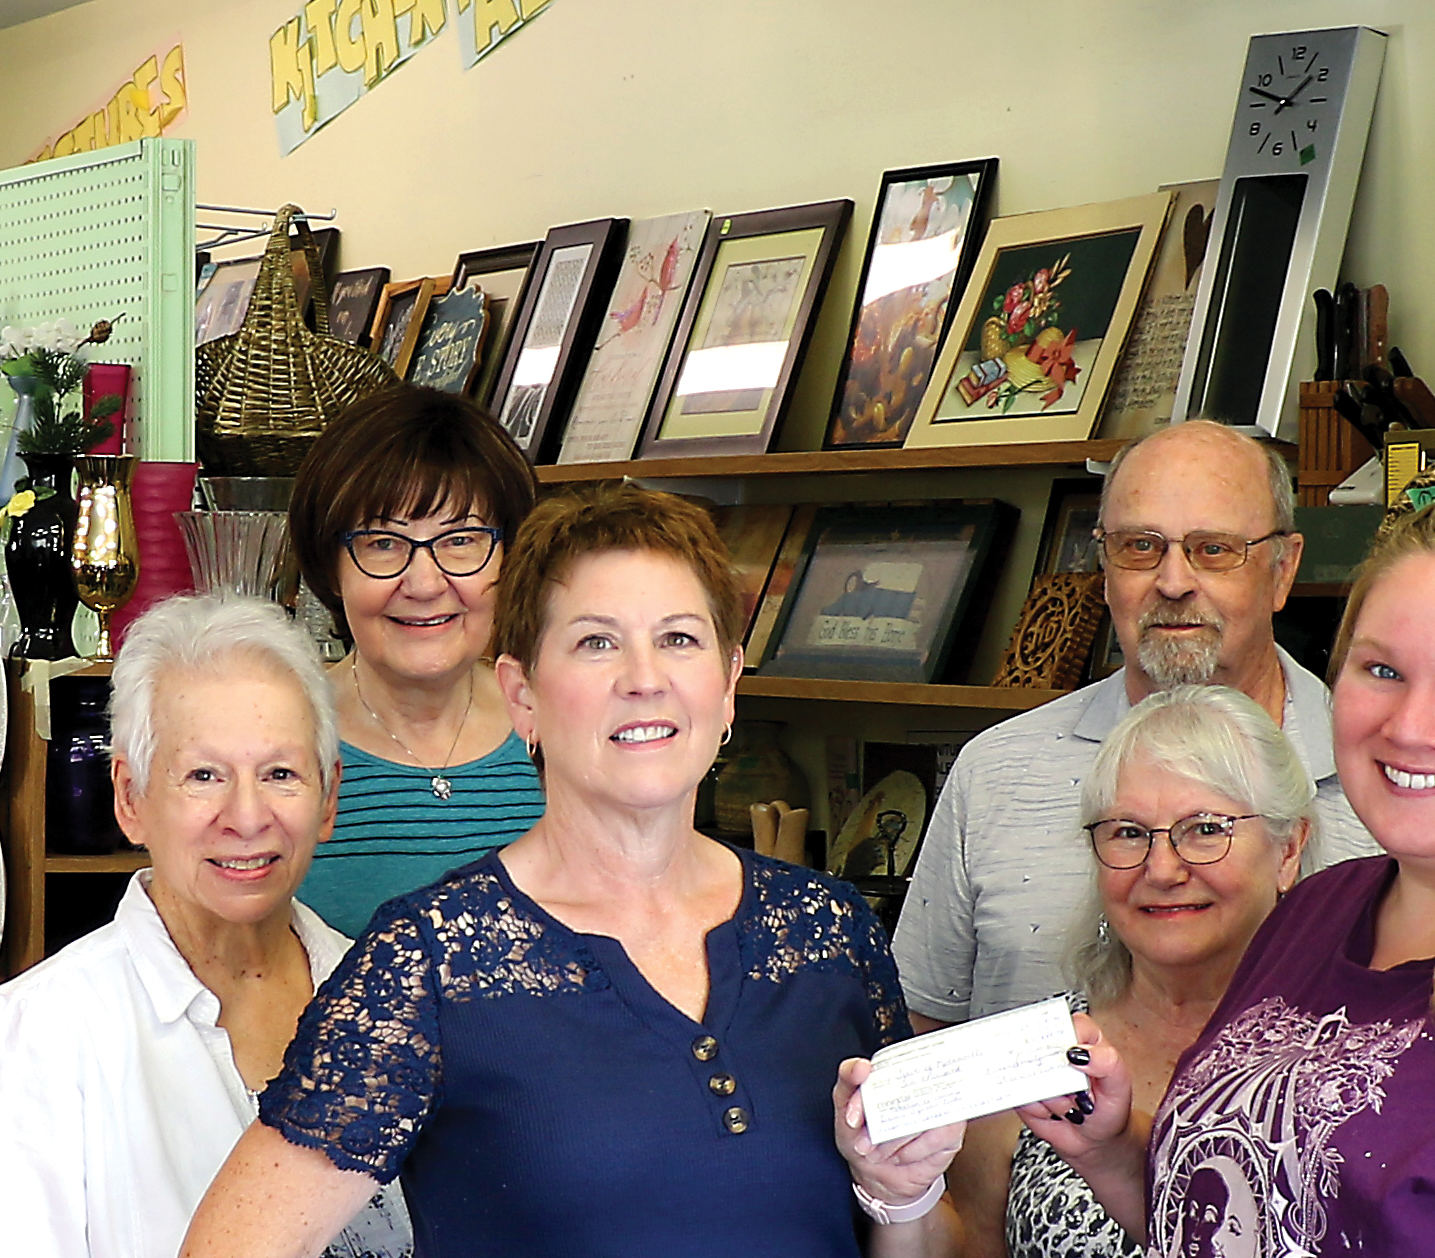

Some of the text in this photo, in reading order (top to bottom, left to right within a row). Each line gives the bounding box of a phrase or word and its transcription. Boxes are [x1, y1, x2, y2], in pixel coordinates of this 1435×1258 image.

[1292, 46, 1307, 60] 12
[1258, 73, 1272, 87] 10
[1317, 68, 1329, 82] 2
[1249, 122, 1261, 136] 8
[1307, 119, 1317, 132] 4
[1272, 142, 1283, 156] 6
